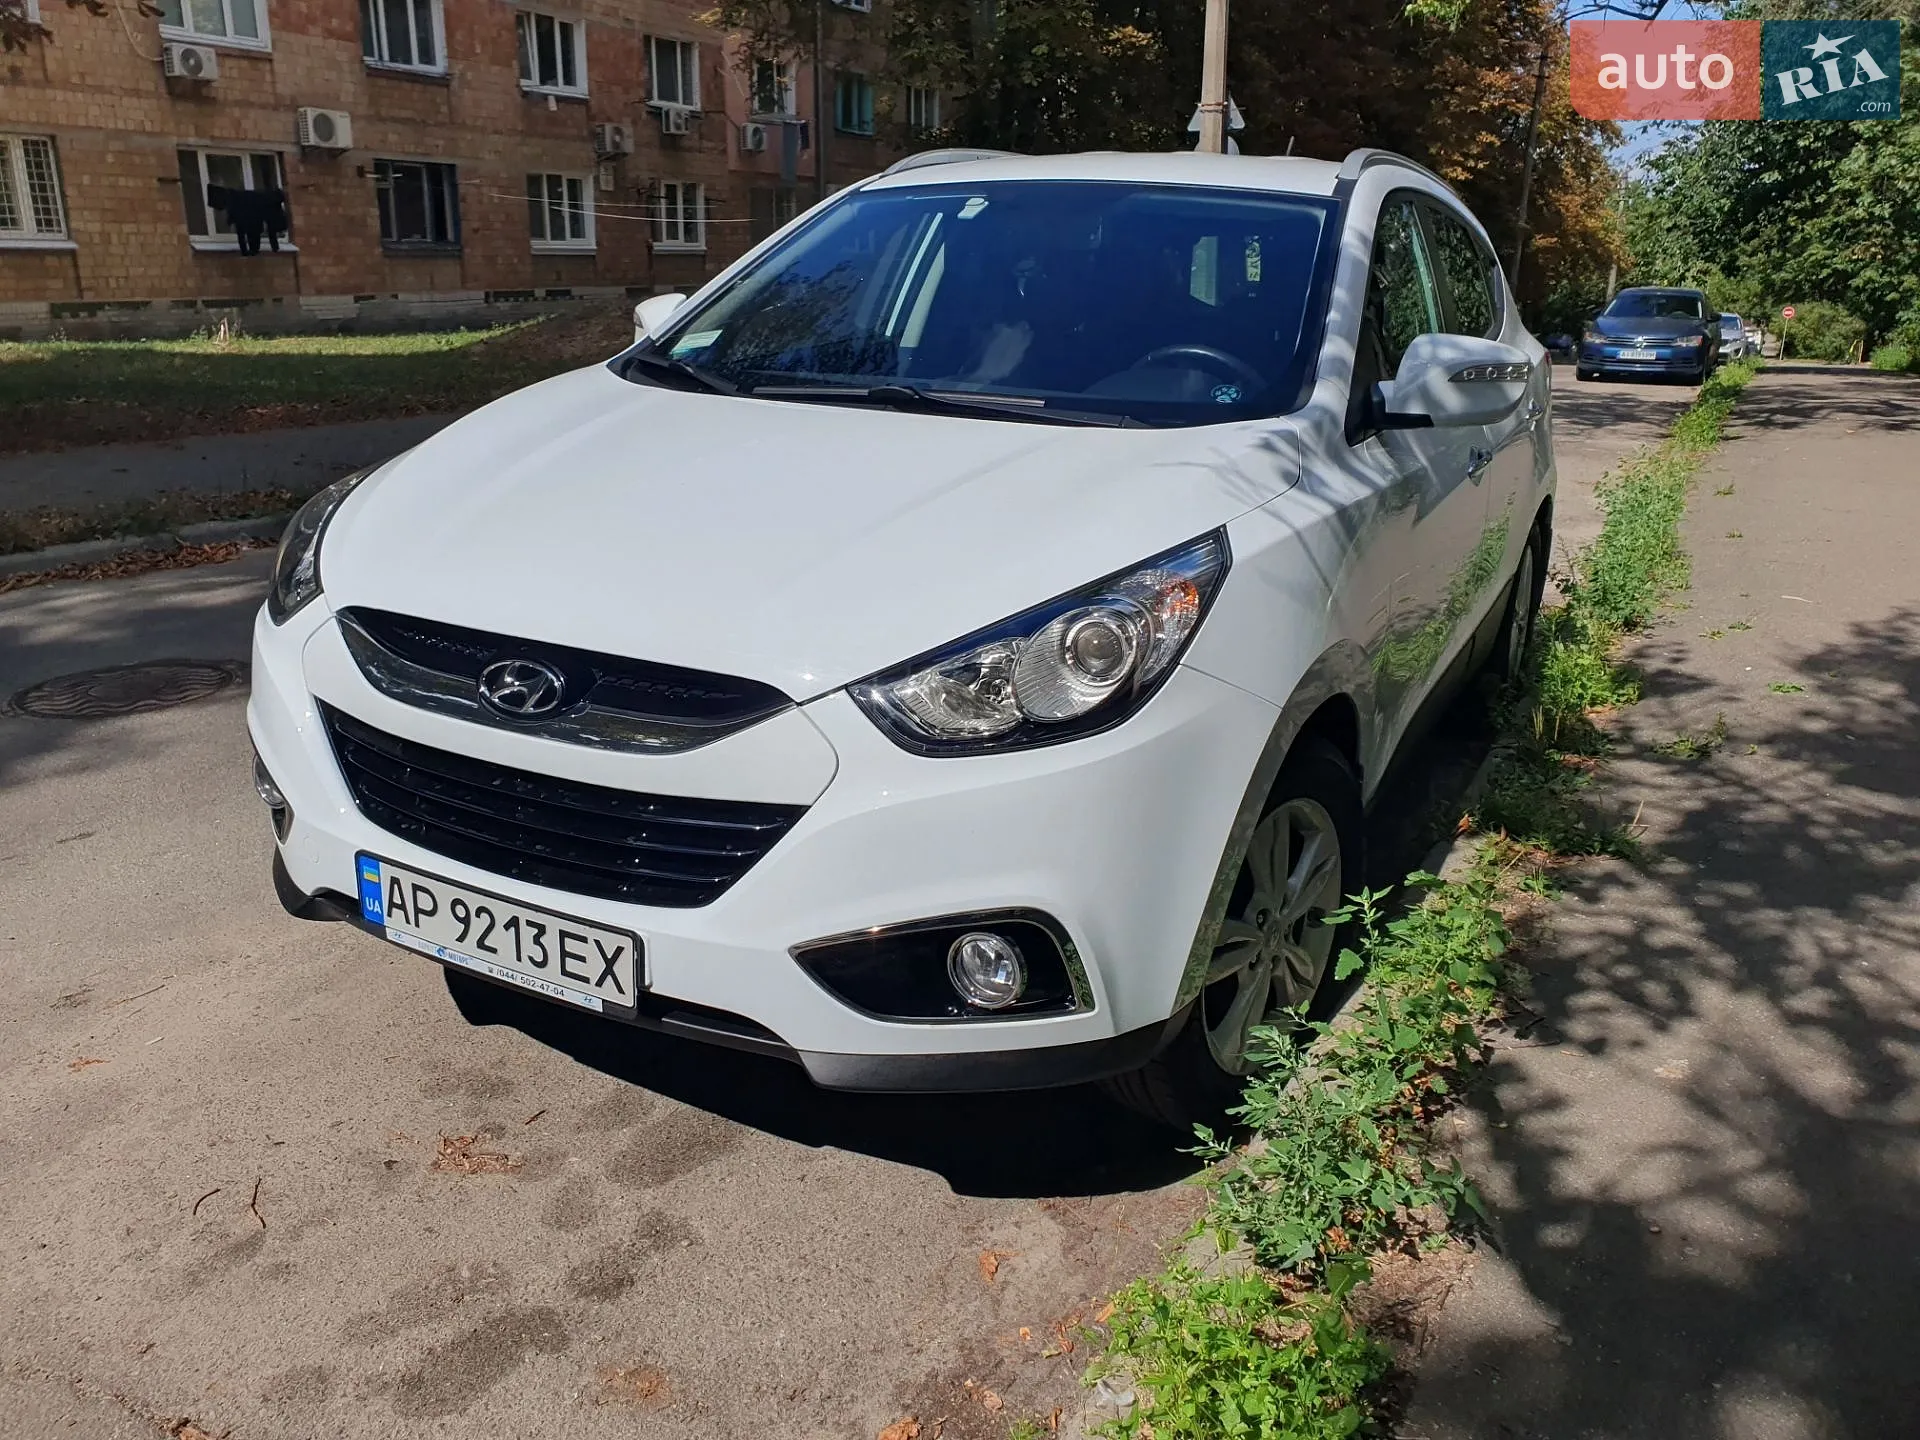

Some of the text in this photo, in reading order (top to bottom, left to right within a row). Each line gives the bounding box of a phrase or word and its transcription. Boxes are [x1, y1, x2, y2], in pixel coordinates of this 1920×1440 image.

[366, 897, 382, 914] UA
[387, 876, 625, 995] AP 9213 EX
[520, 976, 565, 997] 502-47-04
